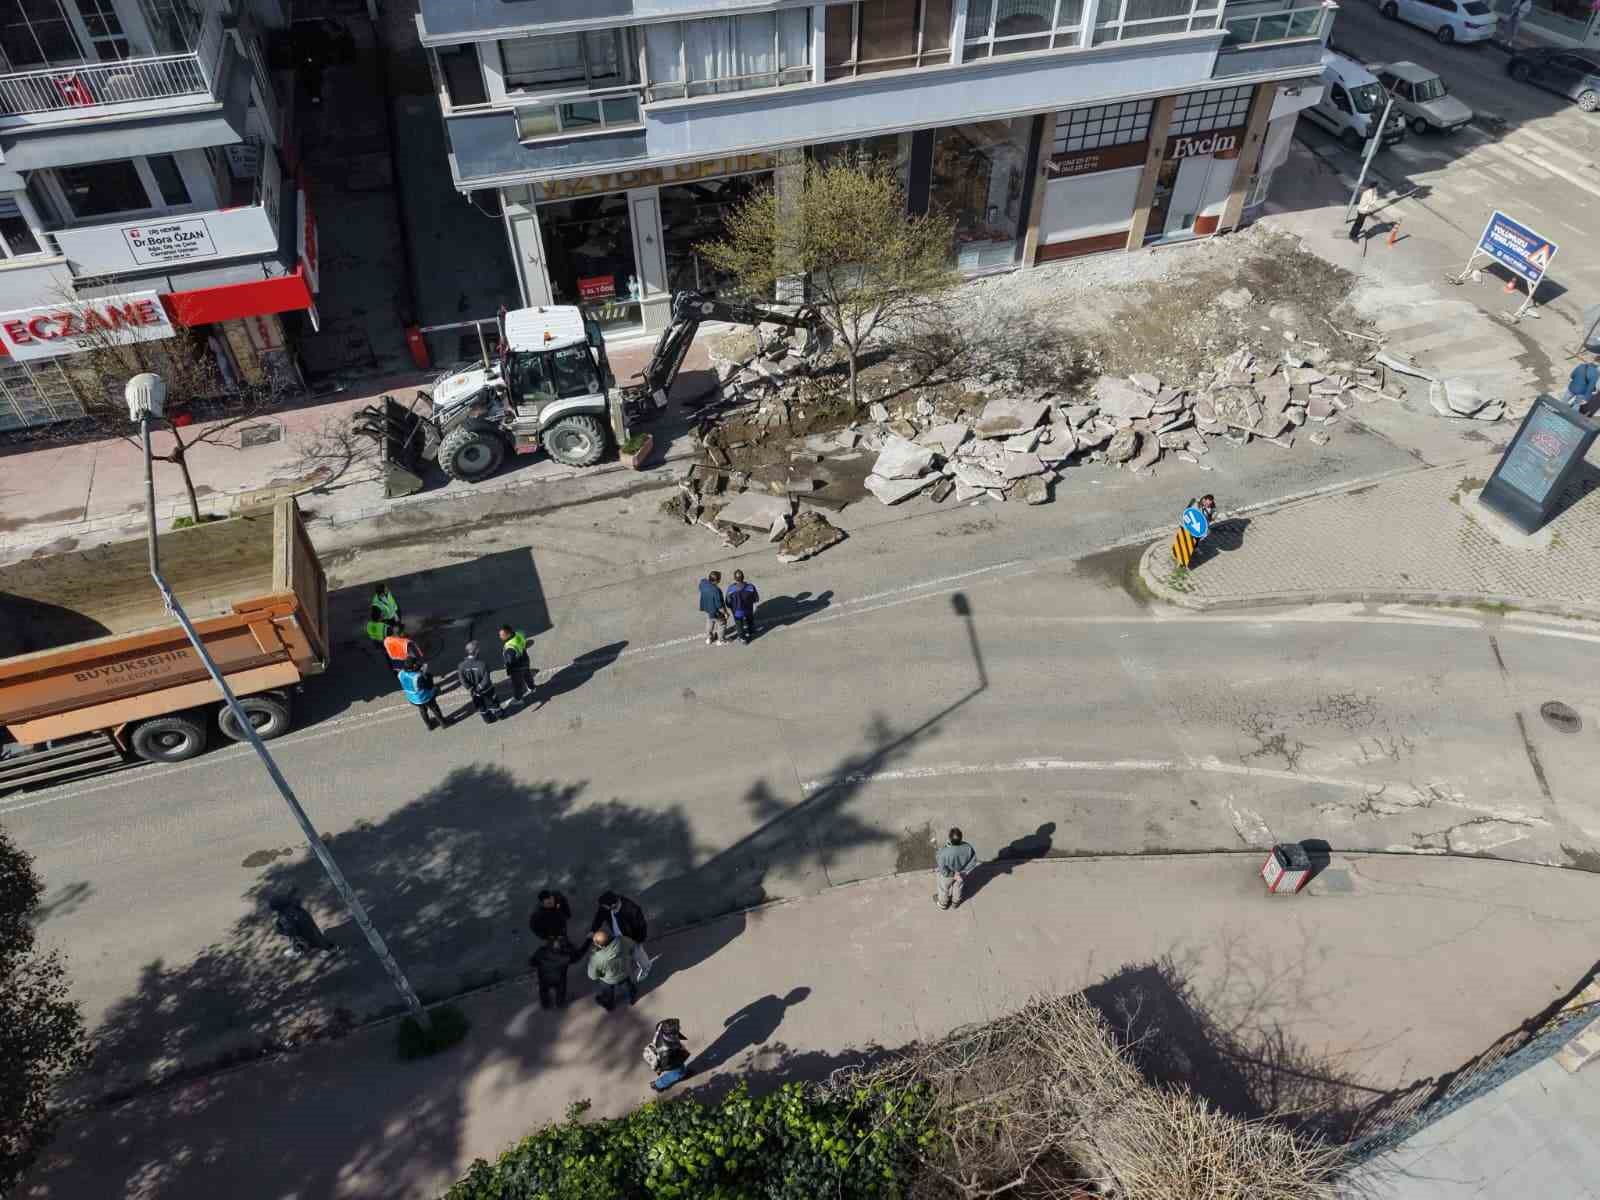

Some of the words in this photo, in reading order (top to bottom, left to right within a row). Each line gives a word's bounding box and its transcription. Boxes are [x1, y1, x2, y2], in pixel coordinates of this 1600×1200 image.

[1171, 132, 1236, 159] Evcim
[174, 231, 204, 241] ÖZAN
[2, 300, 160, 344] ECZANE
